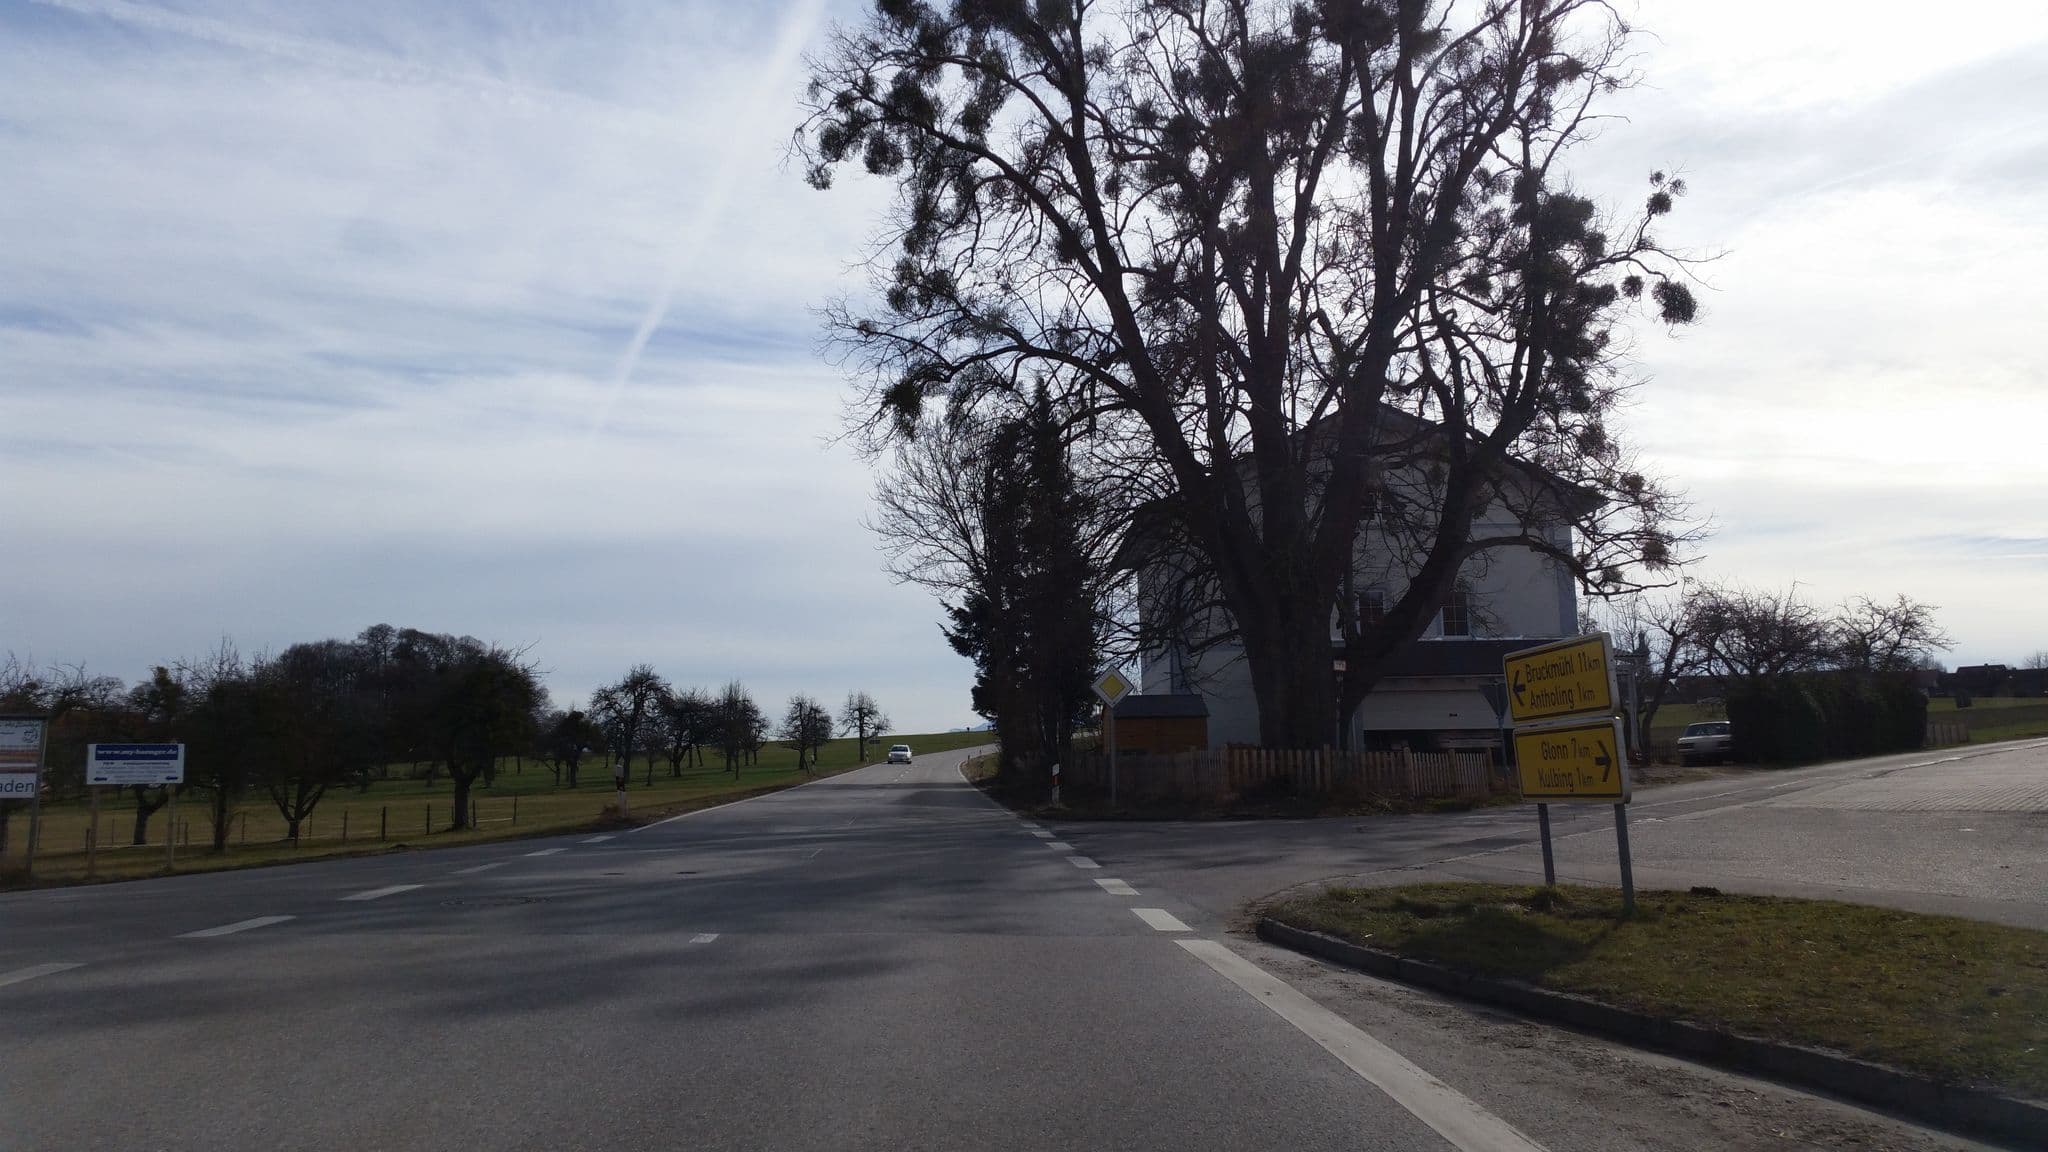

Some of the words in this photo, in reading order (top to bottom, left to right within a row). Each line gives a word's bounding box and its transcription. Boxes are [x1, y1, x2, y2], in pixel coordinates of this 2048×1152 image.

[1525, 655, 1575, 683] Bruckmühl
[1530, 686, 1574, 709] Antholing
[1541, 741, 1569, 760] Glonn
[0, 779, 35, 793] den
[1538, 767, 1574, 792] Kulbing
